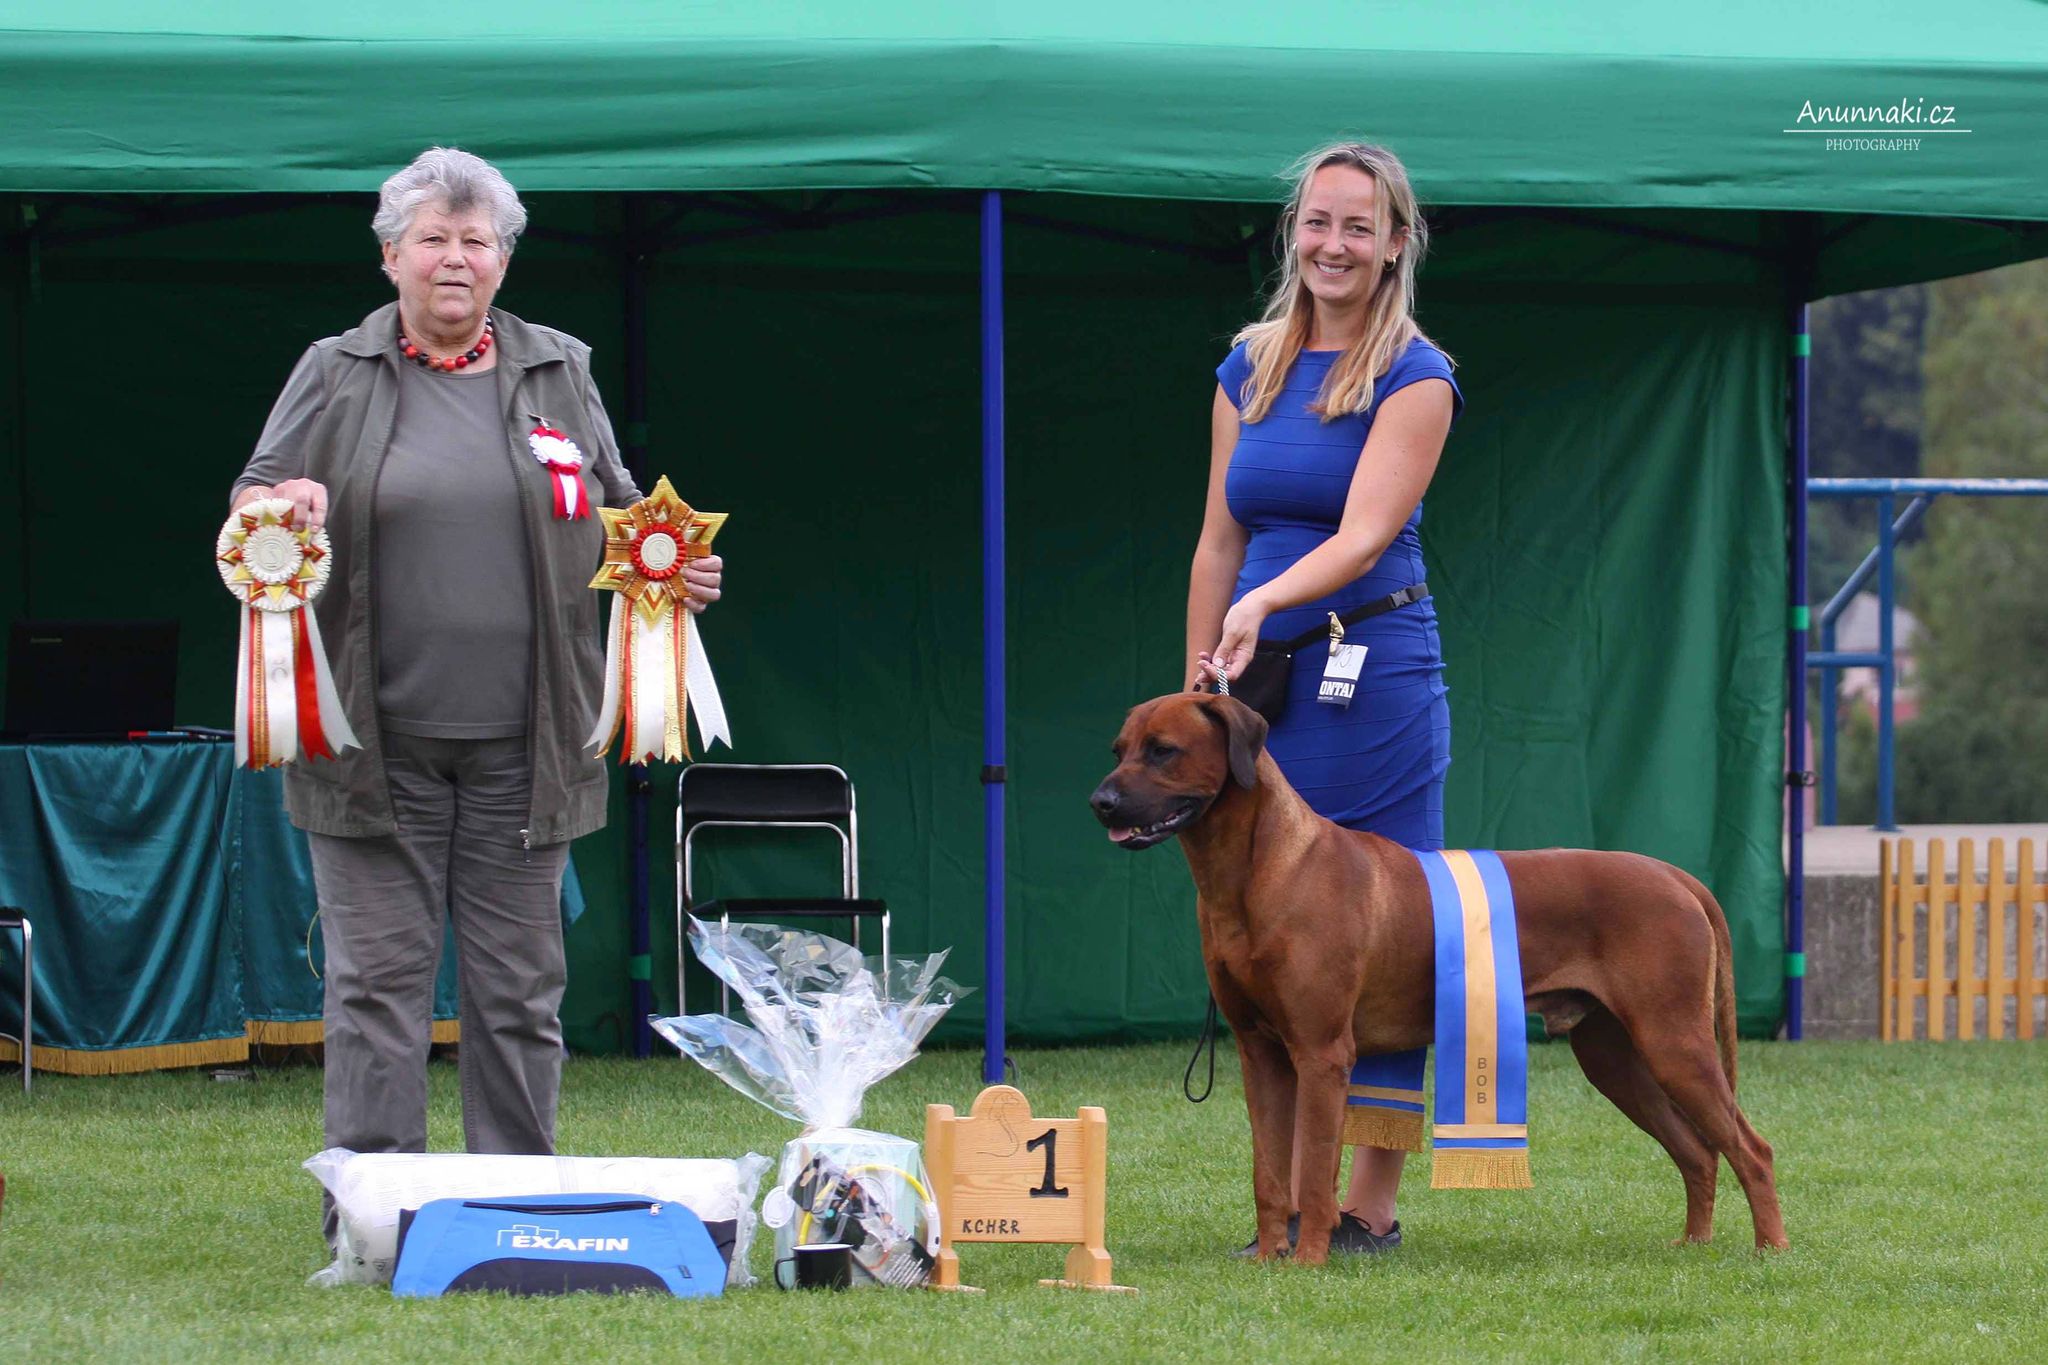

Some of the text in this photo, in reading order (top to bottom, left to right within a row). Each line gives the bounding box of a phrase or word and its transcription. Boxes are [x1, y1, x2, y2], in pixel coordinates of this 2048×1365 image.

[1026, 1128, 1069, 1198] 1
[962, 1219, 1020, 1234] KCHRR
[511, 1235, 629, 1251] EXAFIN
